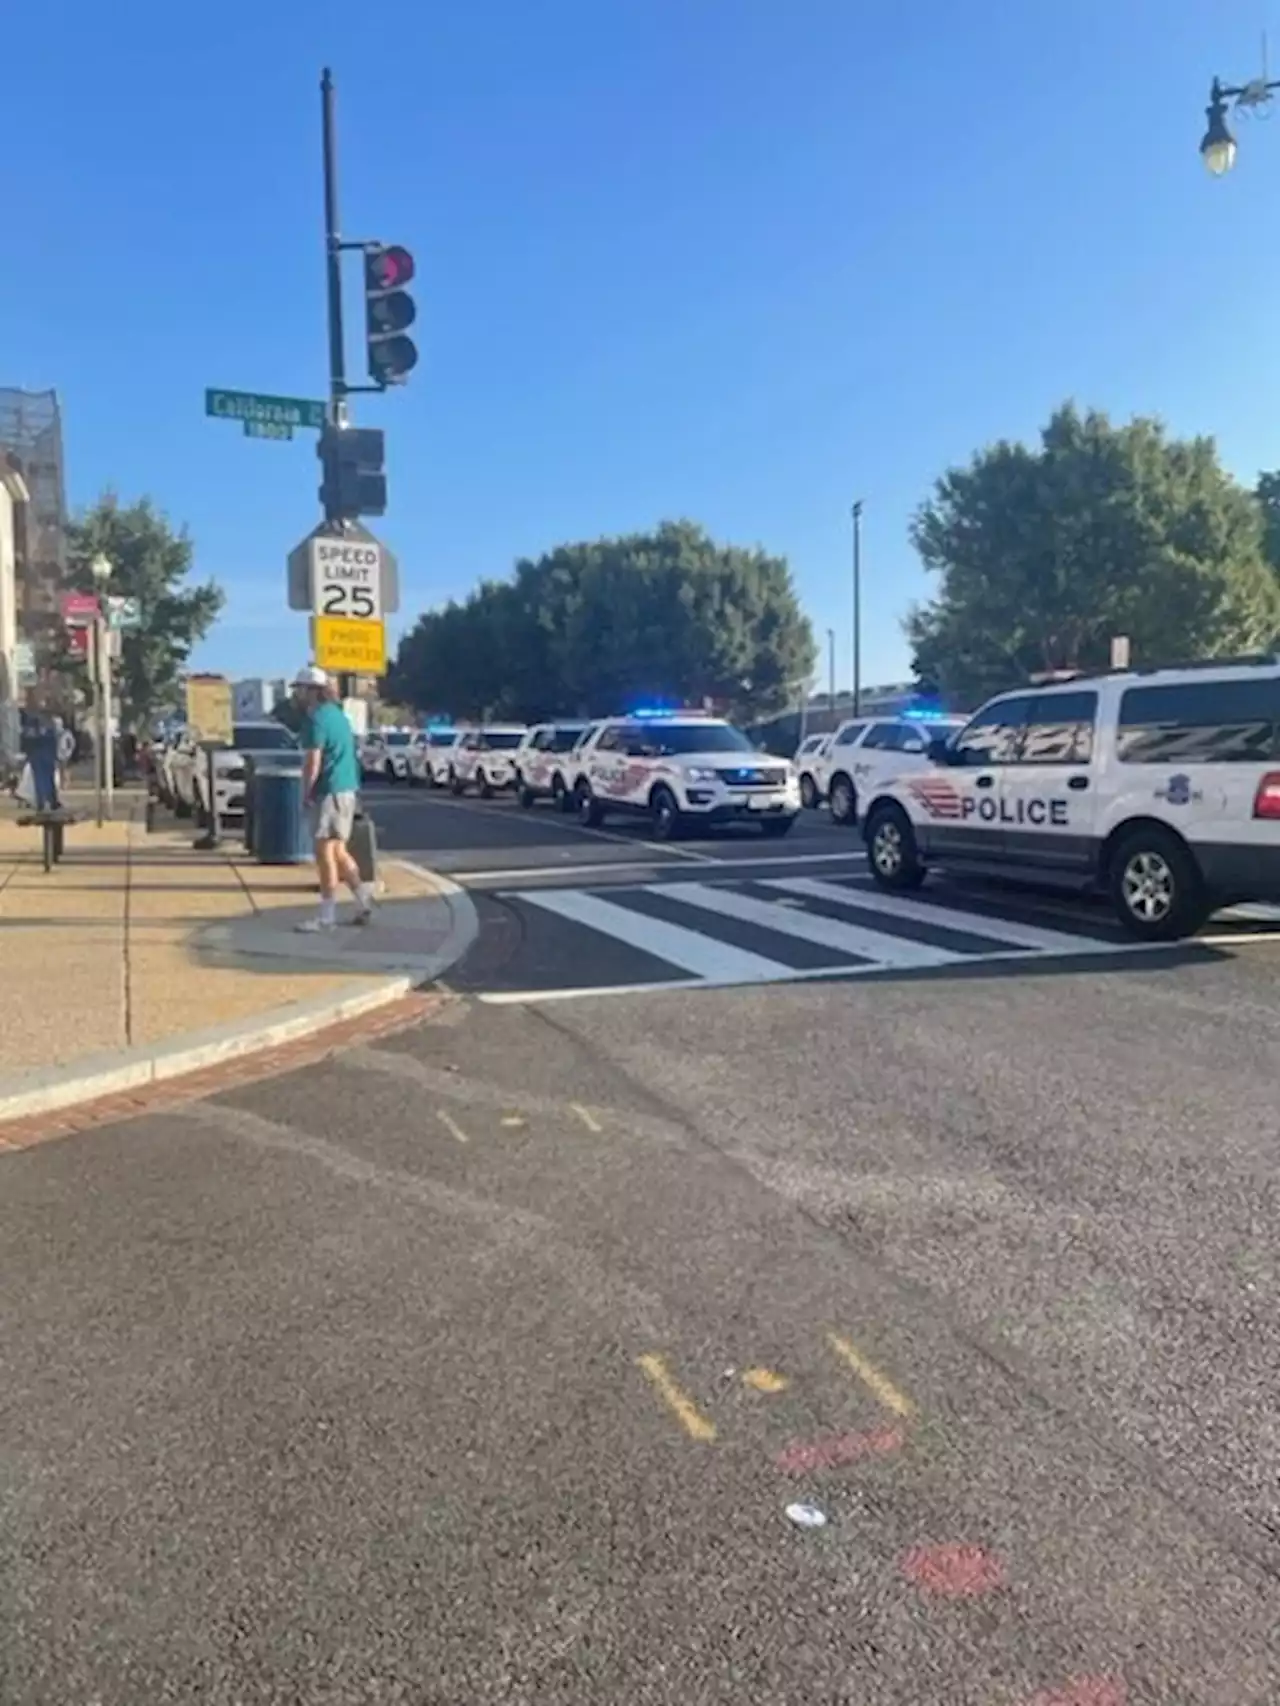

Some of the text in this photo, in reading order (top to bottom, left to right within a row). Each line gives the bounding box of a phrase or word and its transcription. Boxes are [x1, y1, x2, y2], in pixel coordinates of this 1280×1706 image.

[213, 393, 300, 424] California
[318, 546, 377, 564] SPEED
[324, 565, 370, 582] LIMIT
[323, 584, 375, 618] 25
[961, 796, 1069, 826] POLICE
